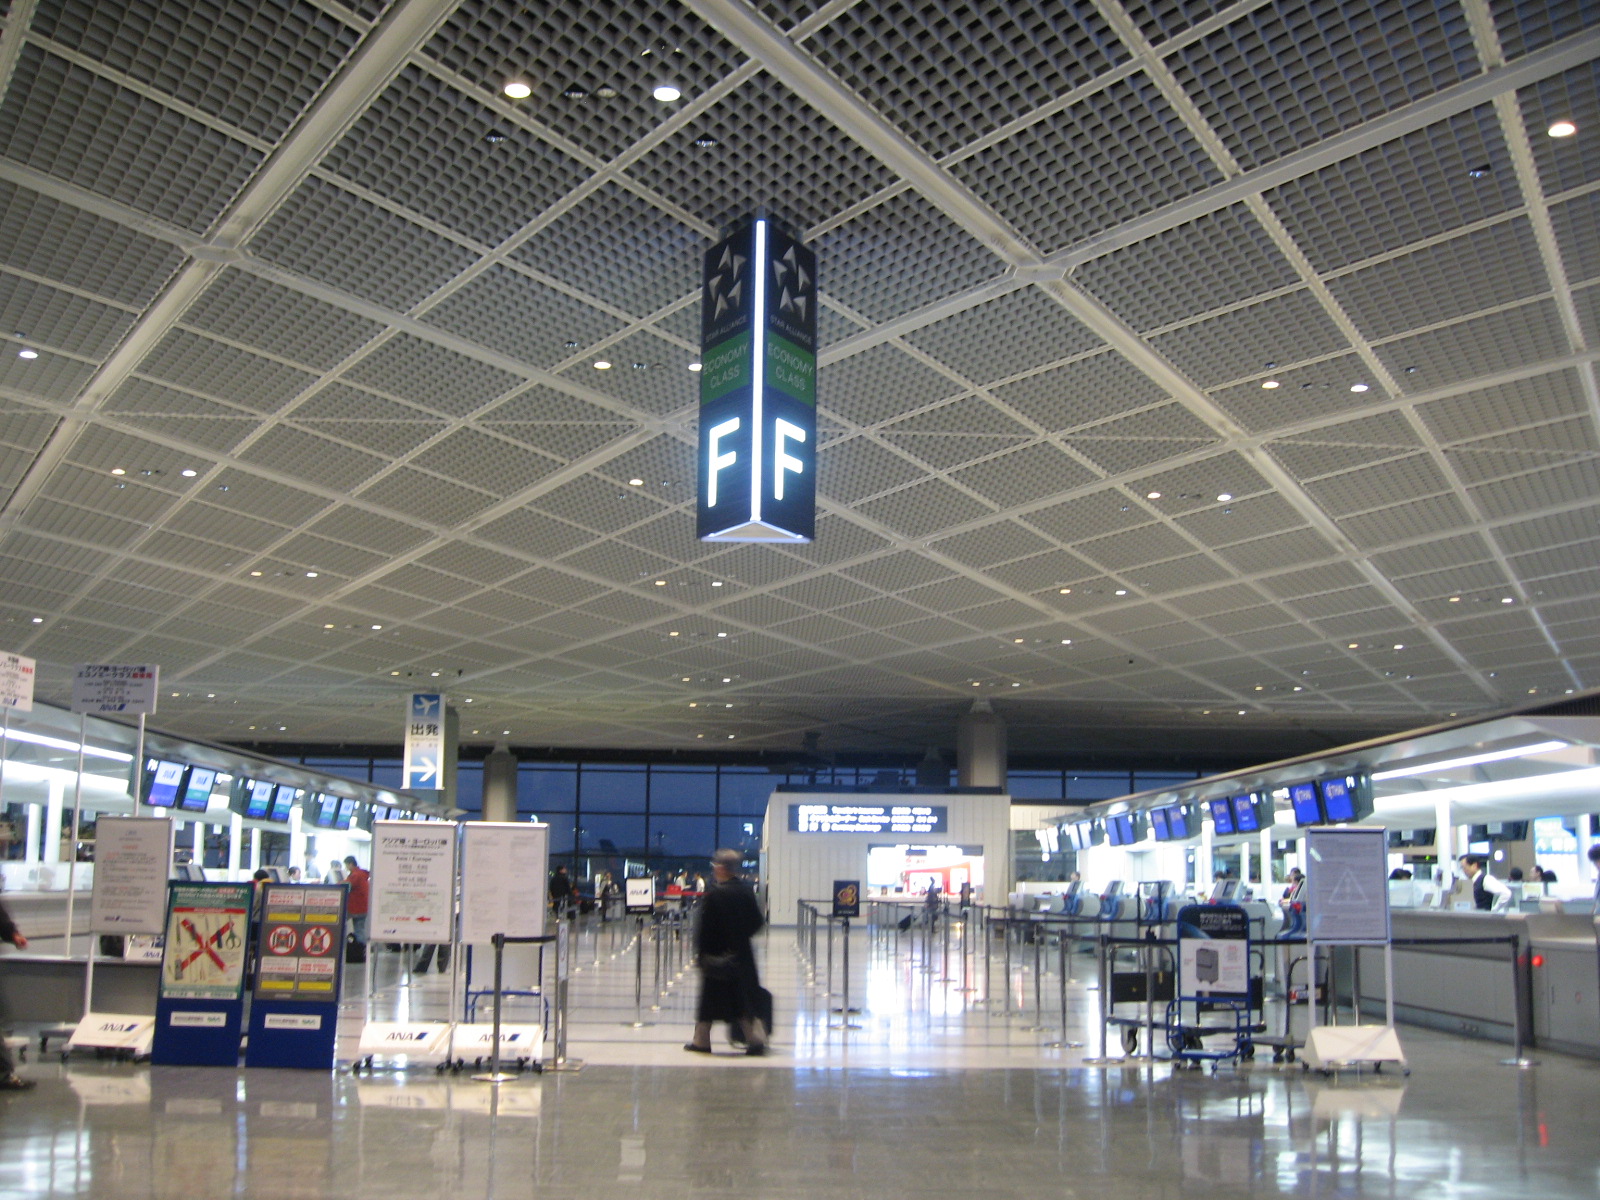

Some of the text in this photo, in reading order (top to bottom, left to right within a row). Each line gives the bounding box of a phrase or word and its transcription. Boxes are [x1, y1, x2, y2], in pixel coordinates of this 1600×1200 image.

[770, 314, 812, 345] STAR ALLIANCE
[703, 343, 748, 376] ECONOMY
[767, 342, 813, 376] ECONOMY
[710, 365, 740, 389] CLASS
[776, 366, 806, 391] CLASS
[708, 416, 740, 508] F
[775, 417, 806, 501] F
[411, 723, 438, 736] 出発
[99, 1023, 125, 1032] ANA
[386, 1032, 414, 1041] ANA
